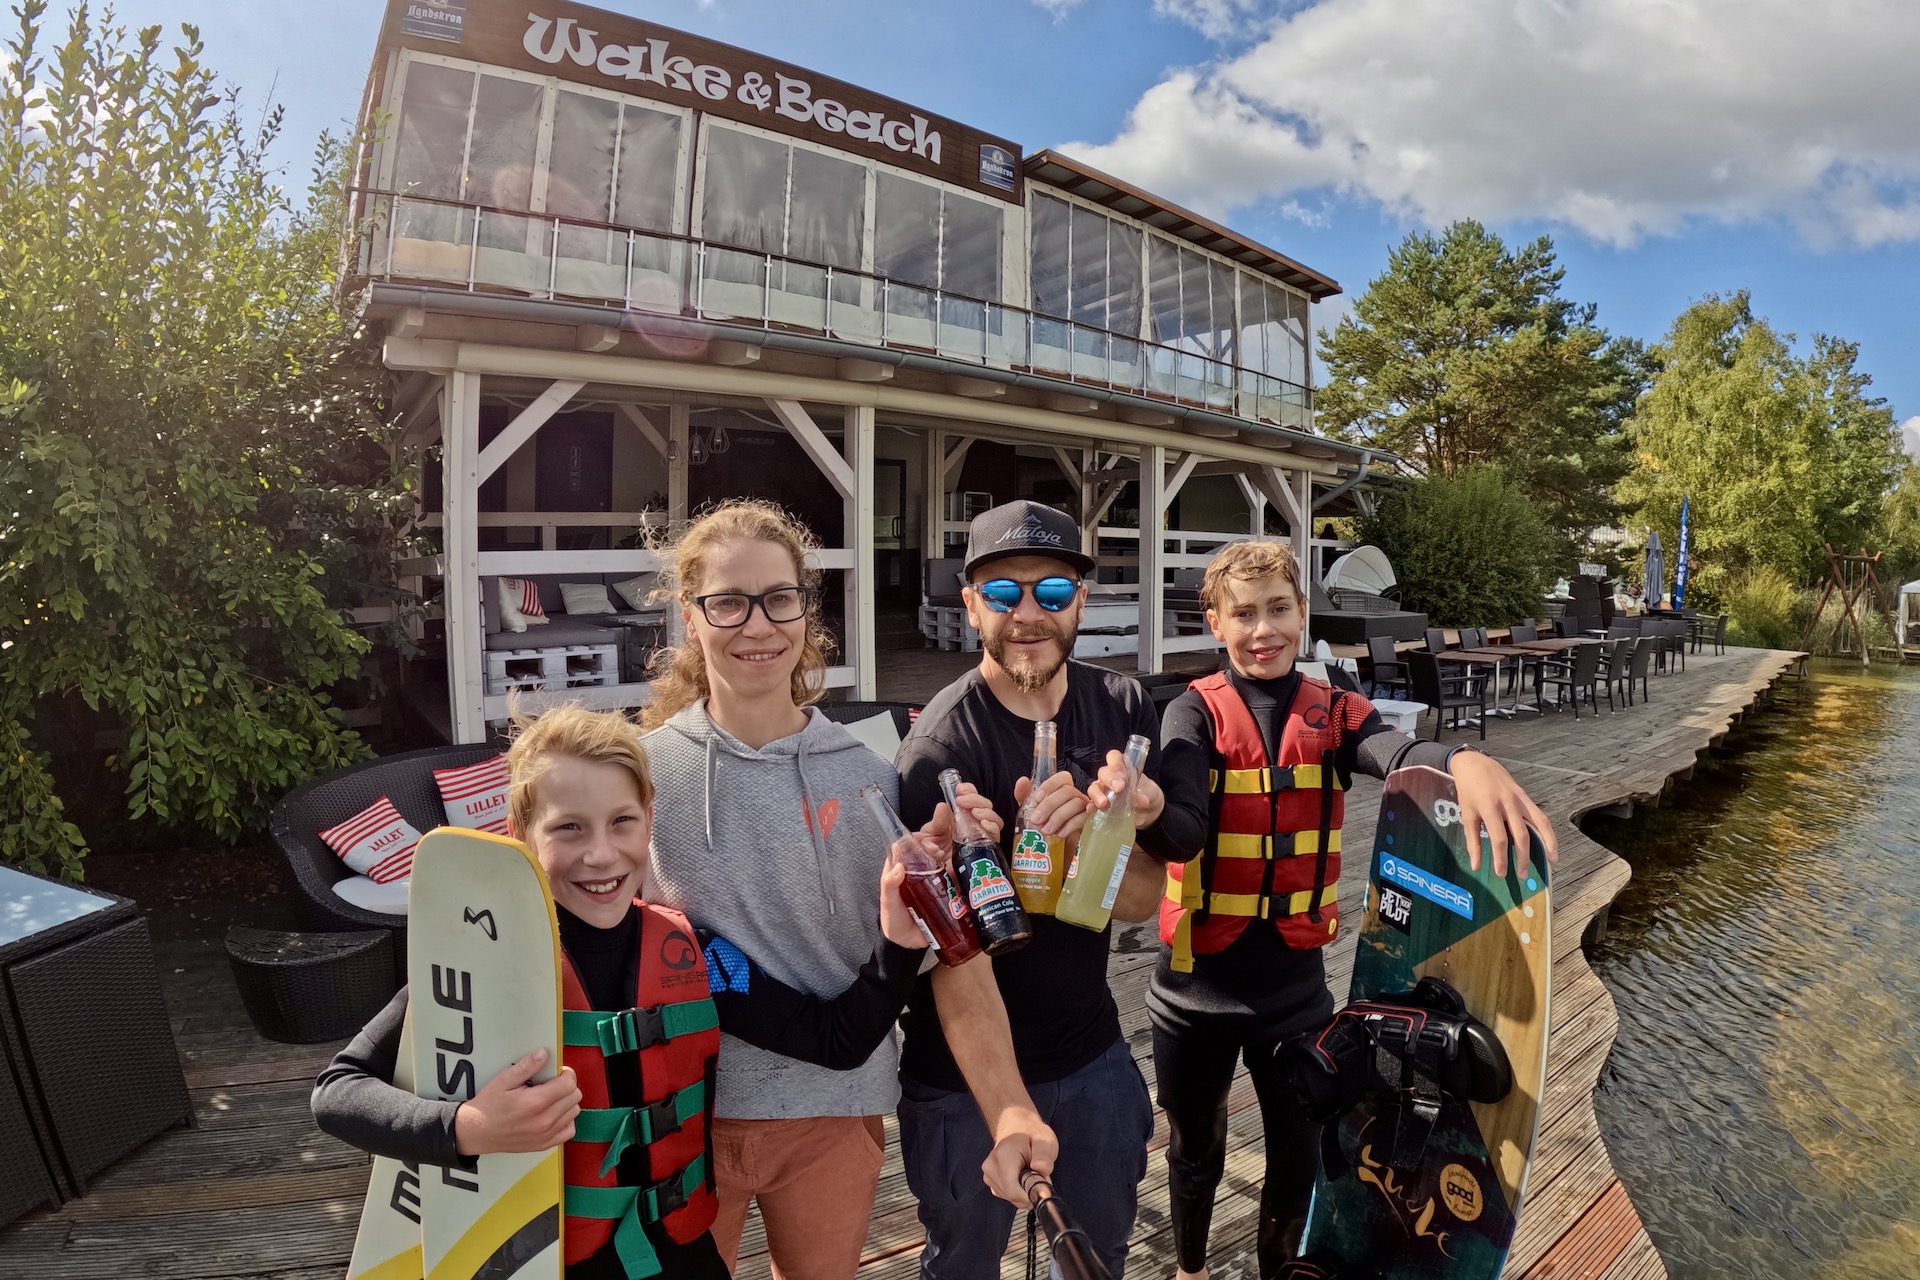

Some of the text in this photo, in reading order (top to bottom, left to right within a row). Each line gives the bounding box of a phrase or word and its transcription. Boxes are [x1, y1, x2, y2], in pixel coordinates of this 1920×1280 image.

[523, 12, 941, 164] Wake & Beach
[995, 522, 1062, 546] Maloja
[466, 794, 507, 815] LILLET
[368, 828, 404, 852] LILLET
[973, 884, 1009, 903] JARRITOS
[1382, 886, 1402, 907] JET
[1397, 866, 1470, 911] SPINERA
[1446, 1181, 1475, 1205] good
